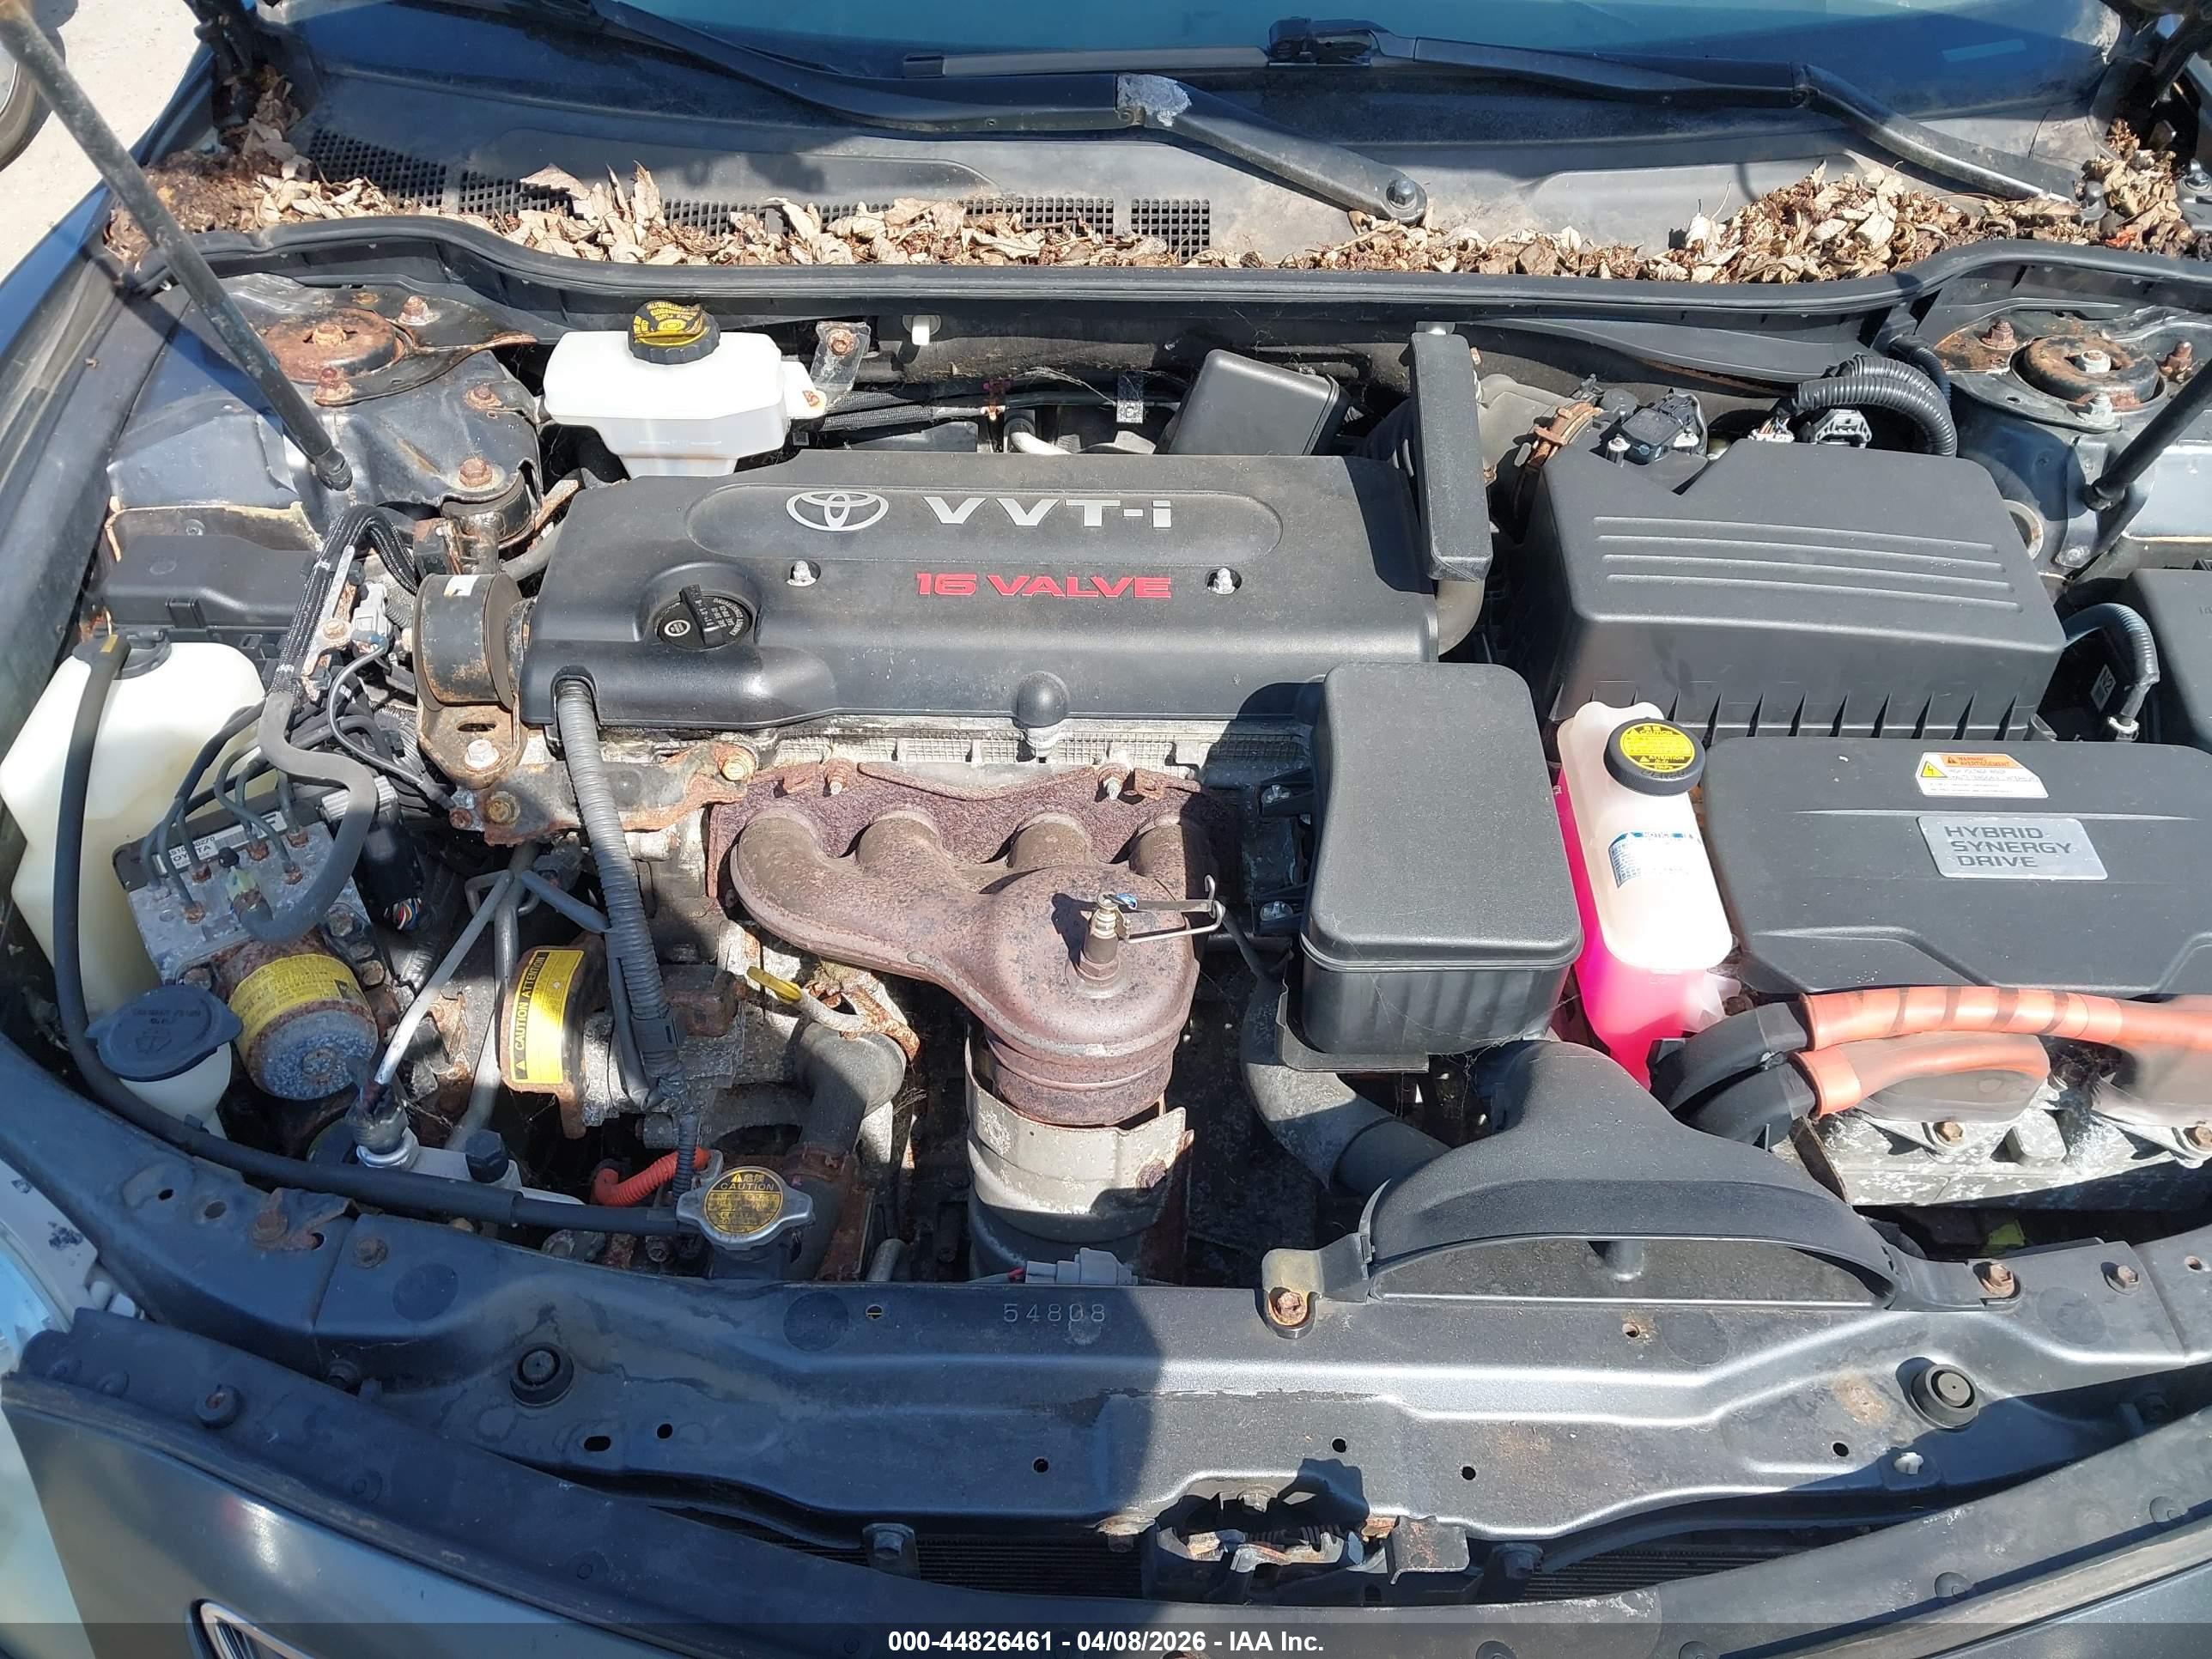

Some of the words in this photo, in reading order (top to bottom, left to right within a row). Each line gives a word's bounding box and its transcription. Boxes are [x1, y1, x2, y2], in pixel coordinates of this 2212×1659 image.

[923, 496, 1172, 528] VVT-i
[915, 573, 977, 596] 16
[988, 574, 1171, 598] VALVE
[1943, 825, 2044, 839] HYBRID
[1950, 841, 2073, 854] SYNERGY
[1956, 855, 2039, 868] DRIVE
[515, 1002, 528, 1051] CAUTION
[522, 956, 546, 998] ATTENTION
[720, 1182, 775, 1191] CAUTION
[1003, 1304, 1106, 1322] 54808
